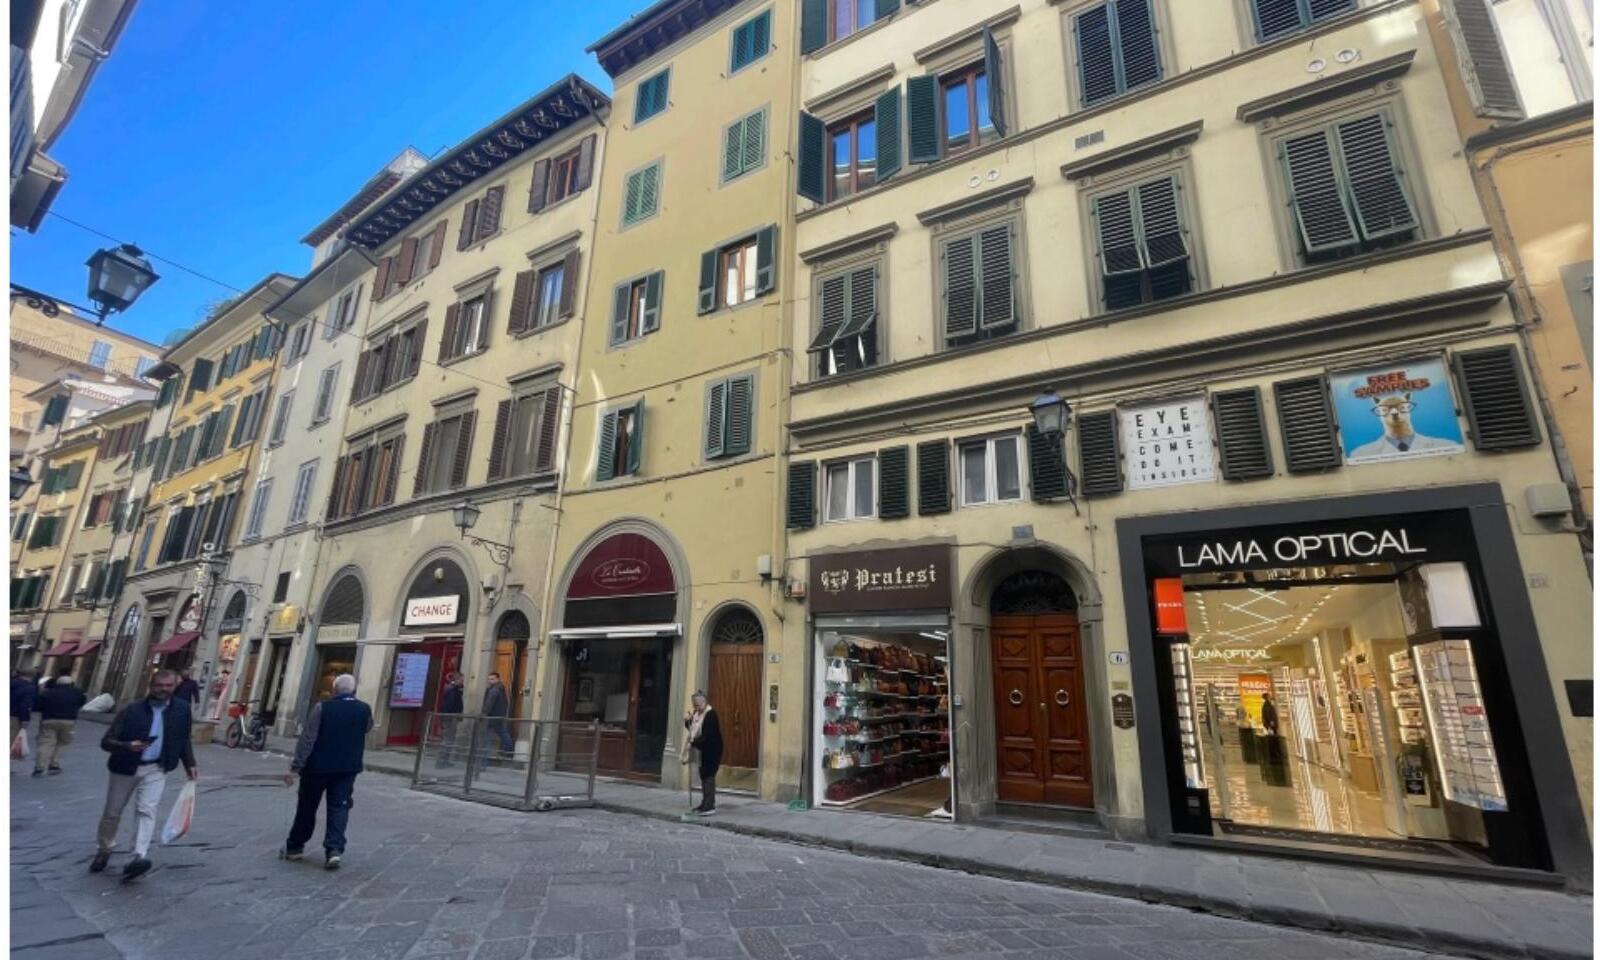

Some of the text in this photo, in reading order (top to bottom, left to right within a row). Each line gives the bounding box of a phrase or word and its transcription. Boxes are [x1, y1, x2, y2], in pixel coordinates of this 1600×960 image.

[1366, 370, 1406, 386] FREE
[1354, 378, 1431, 398] SAMPLES
[1135, 406, 1189, 427] EYE
[1138, 423, 1191, 439] EXAM
[1140, 440, 1194, 455] COME
[1178, 454, 1195, 465] IT
[1178, 529, 1427, 568] LAMA OPTICAL
[855, 564, 937, 591] Pratesi
[411, 603, 453, 617] CHANGE
[1223, 648, 1272, 660] OPTICAL
